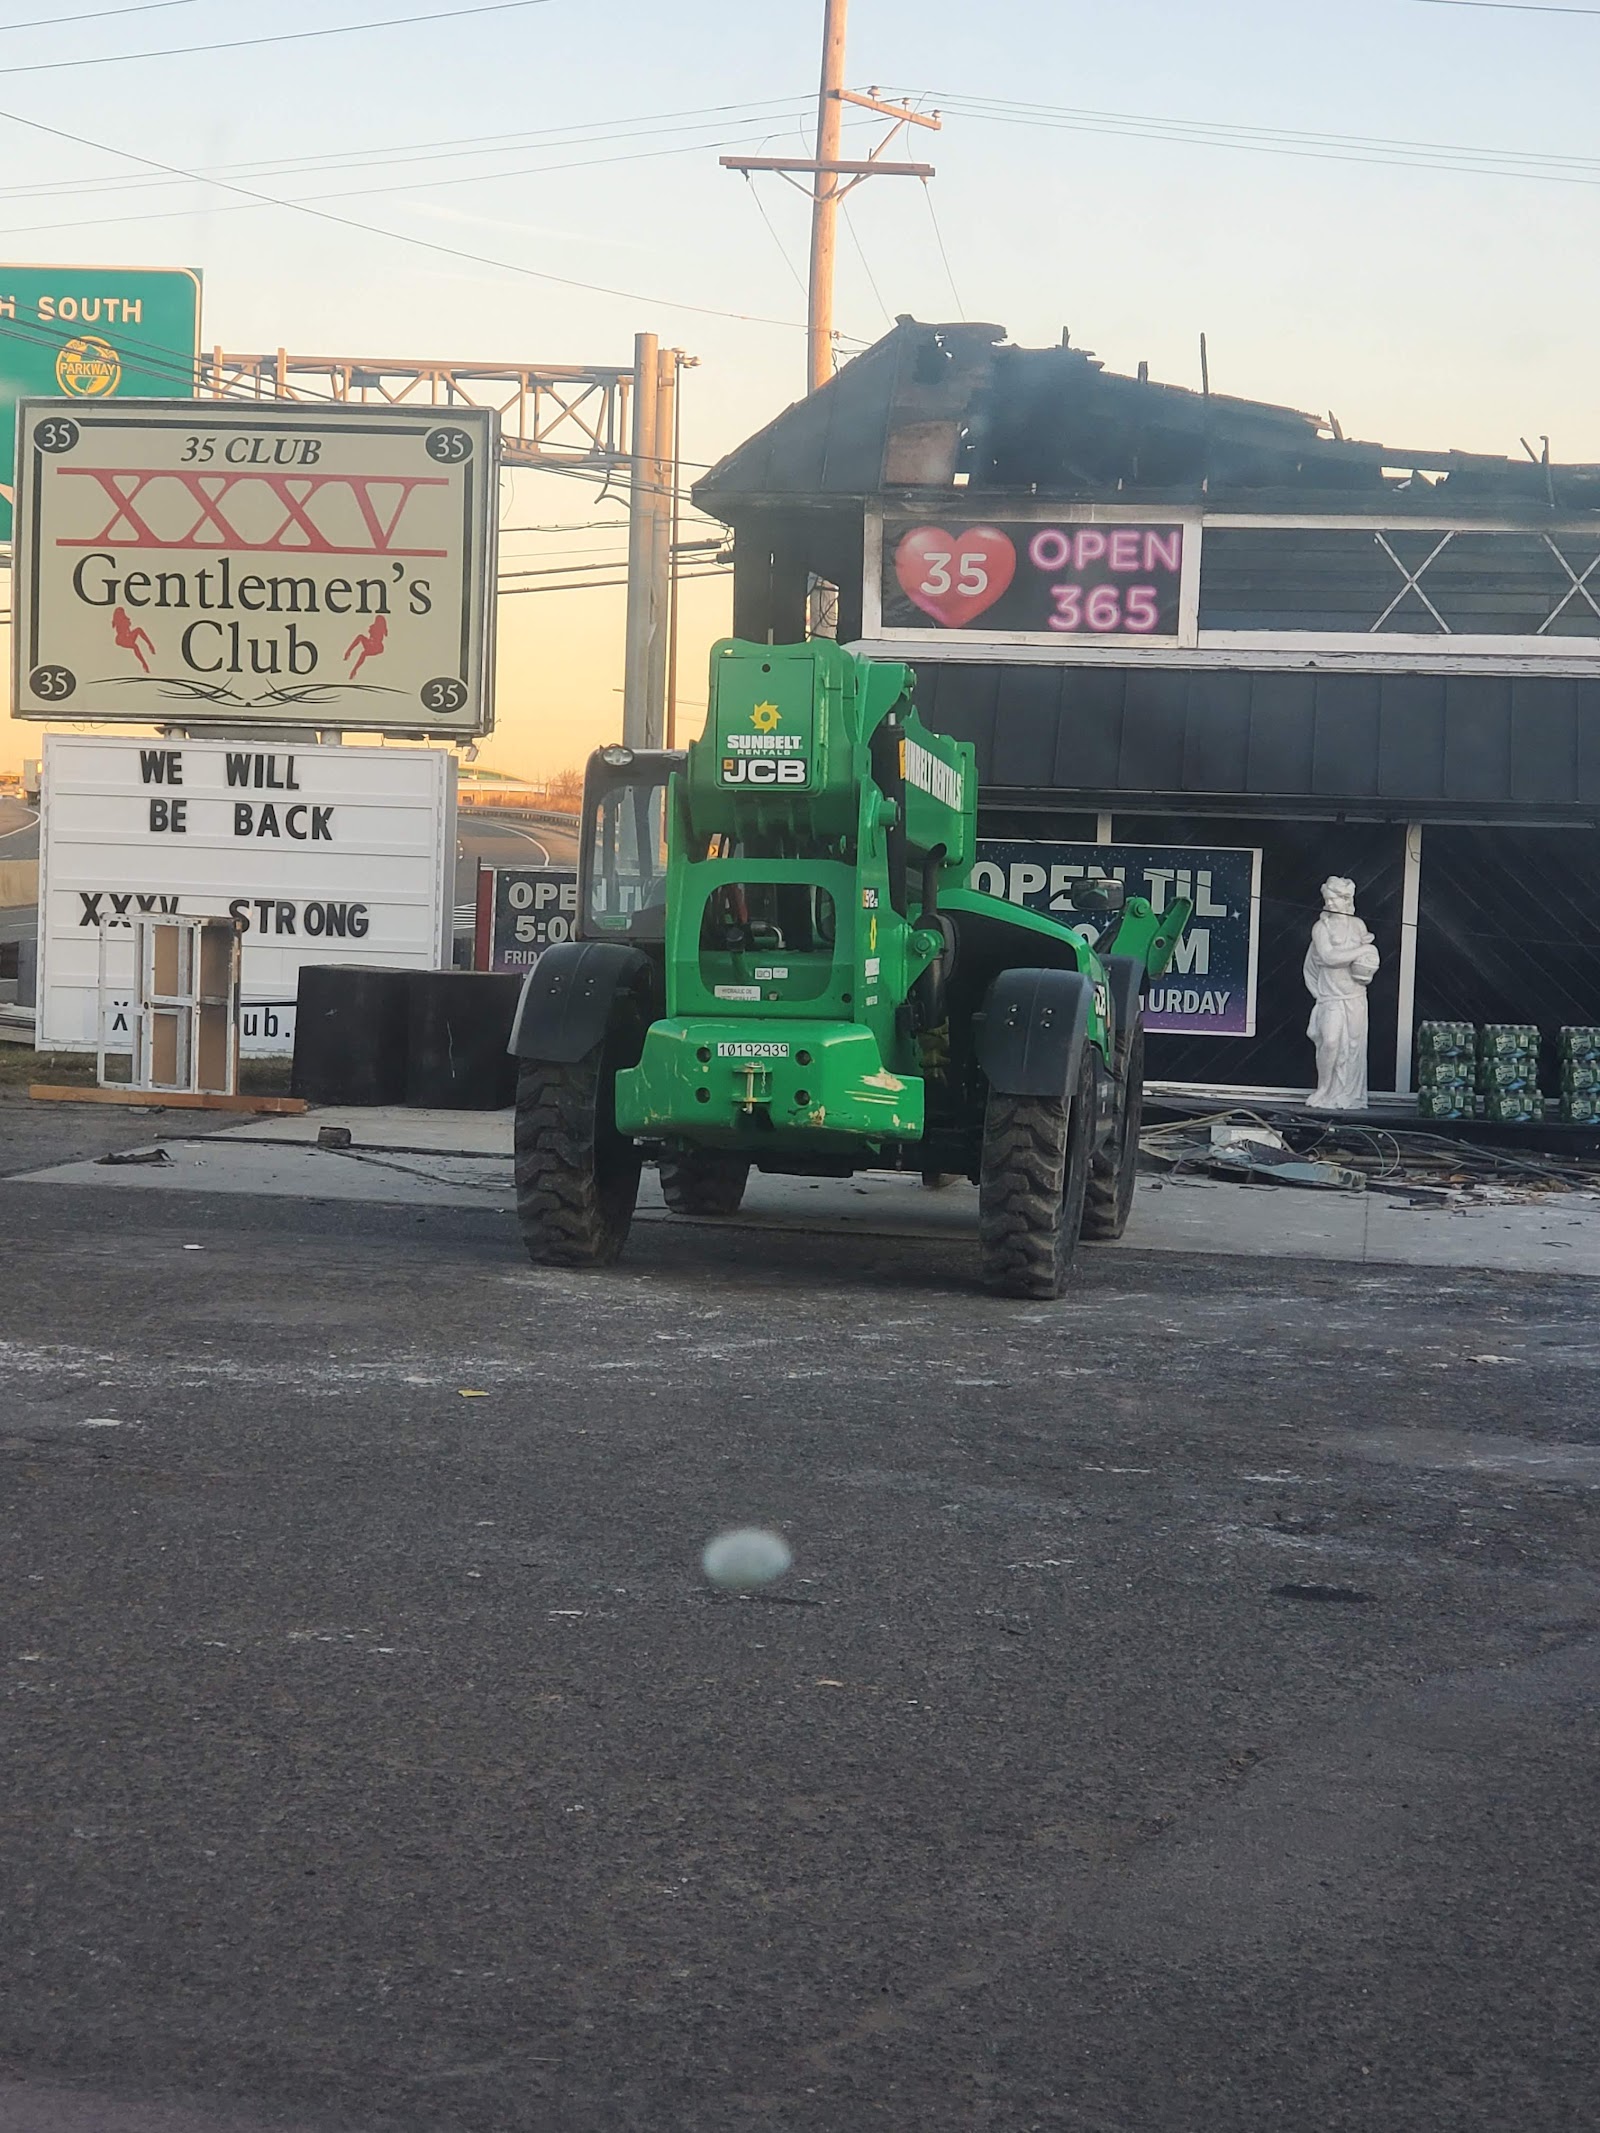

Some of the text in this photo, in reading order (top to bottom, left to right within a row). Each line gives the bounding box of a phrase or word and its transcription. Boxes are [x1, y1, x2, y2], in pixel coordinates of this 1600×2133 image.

[38, 296, 142, 323] SOUTH
[60, 362, 116, 375] PARKWAY
[43, 423, 71, 444] 35
[436, 433, 465, 458] 35
[181, 437, 322, 465] 35 CLUB
[56, 467, 449, 557] XXXV
[1029, 529, 1181, 572] OPEN
[73, 553, 432, 615] Gentlemen's
[920, 552, 988, 596] 35
[1048, 584, 1159, 632] 365
[181, 620, 318, 674] Club
[39, 670, 68, 695] 35
[431, 683, 459, 708] 35
[727, 734, 802, 749] SUNBELT
[737, 748, 791, 756] RENTALS
[140, 751, 299, 790] WE WILL
[723, 759, 806, 783] JCB
[149, 799, 334, 841] BE BACK
[1143, 868, 1227, 917] TIL
[229, 899, 369, 938] STRONG
[719, 1043, 789, 1056] 10192939
